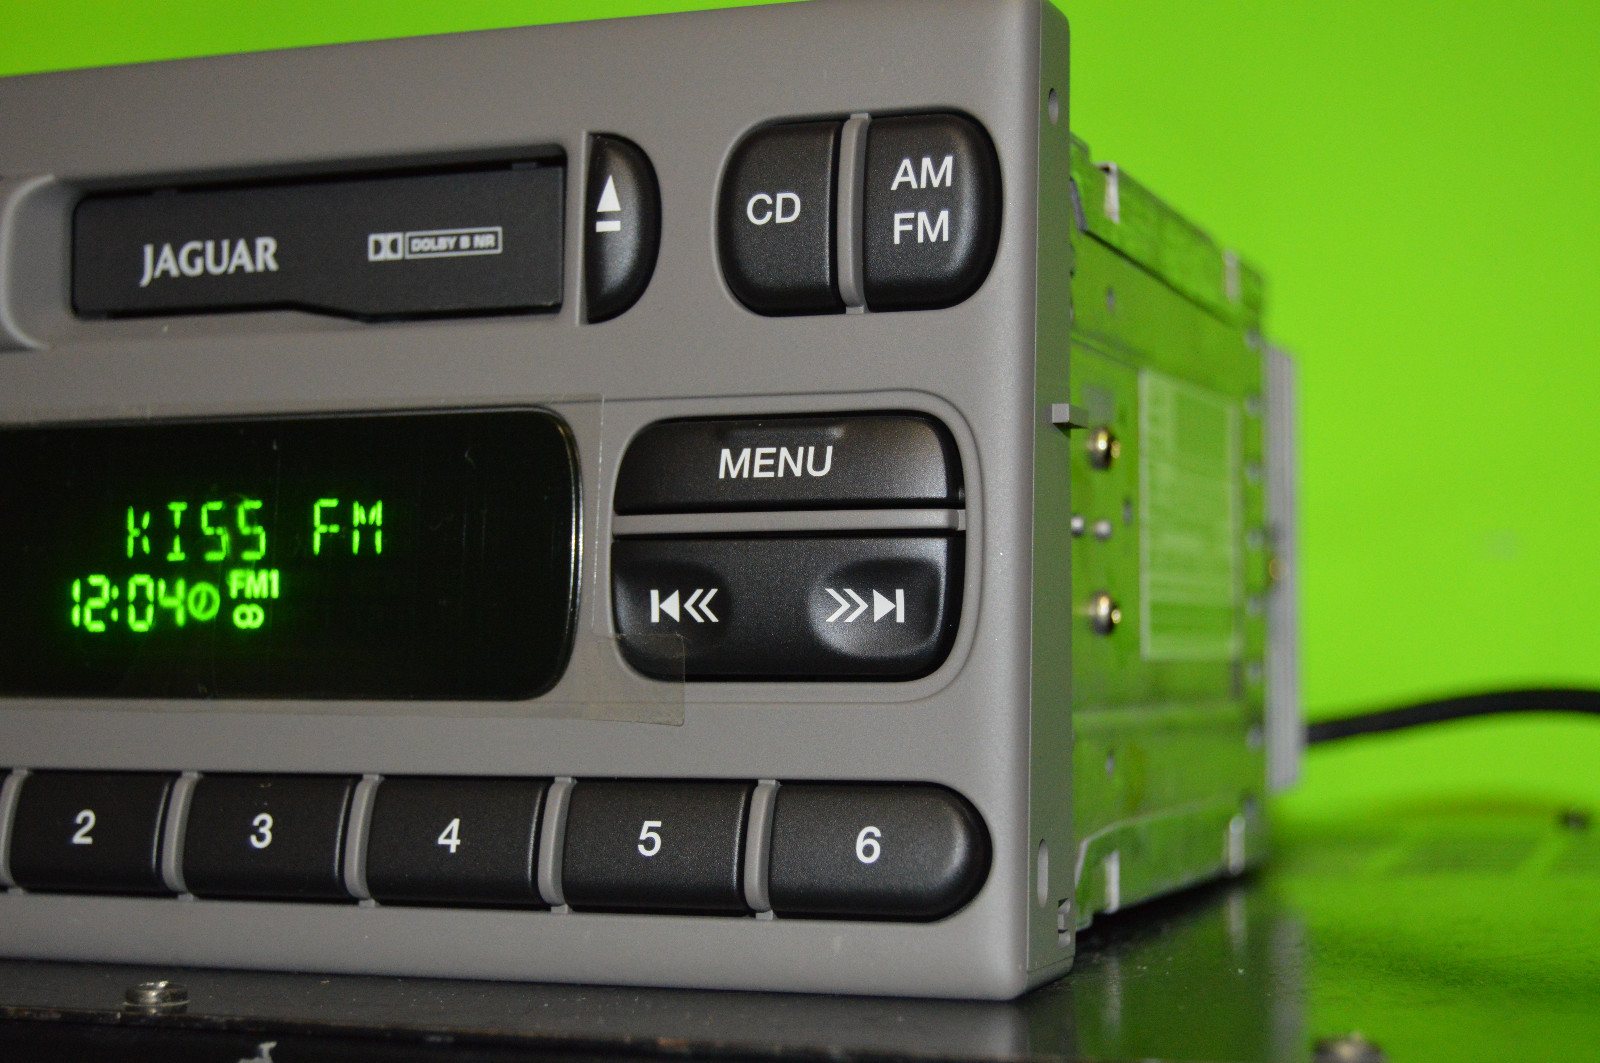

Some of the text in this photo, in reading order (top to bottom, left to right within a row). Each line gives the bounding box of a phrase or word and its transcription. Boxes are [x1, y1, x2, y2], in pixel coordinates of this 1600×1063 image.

[890, 155, 953, 191] AM
[746, 191, 801, 226] CD
[410, 233, 496, 253] DOLBY B NR
[893, 210, 950, 245] FM
[139, 236, 279, 287] JAGUAR
[718, 445, 834, 479] MENU
[126, 498, 383, 562] KISS FM
[226, 568, 280, 599] FM1
[71, 573, 190, 633] 12:04
[71, 809, 96, 846] 2
[249, 813, 274, 849] 3
[437, 818, 461, 854] 4
[637, 820, 662, 857] 5
[855, 825, 882, 864] 6
